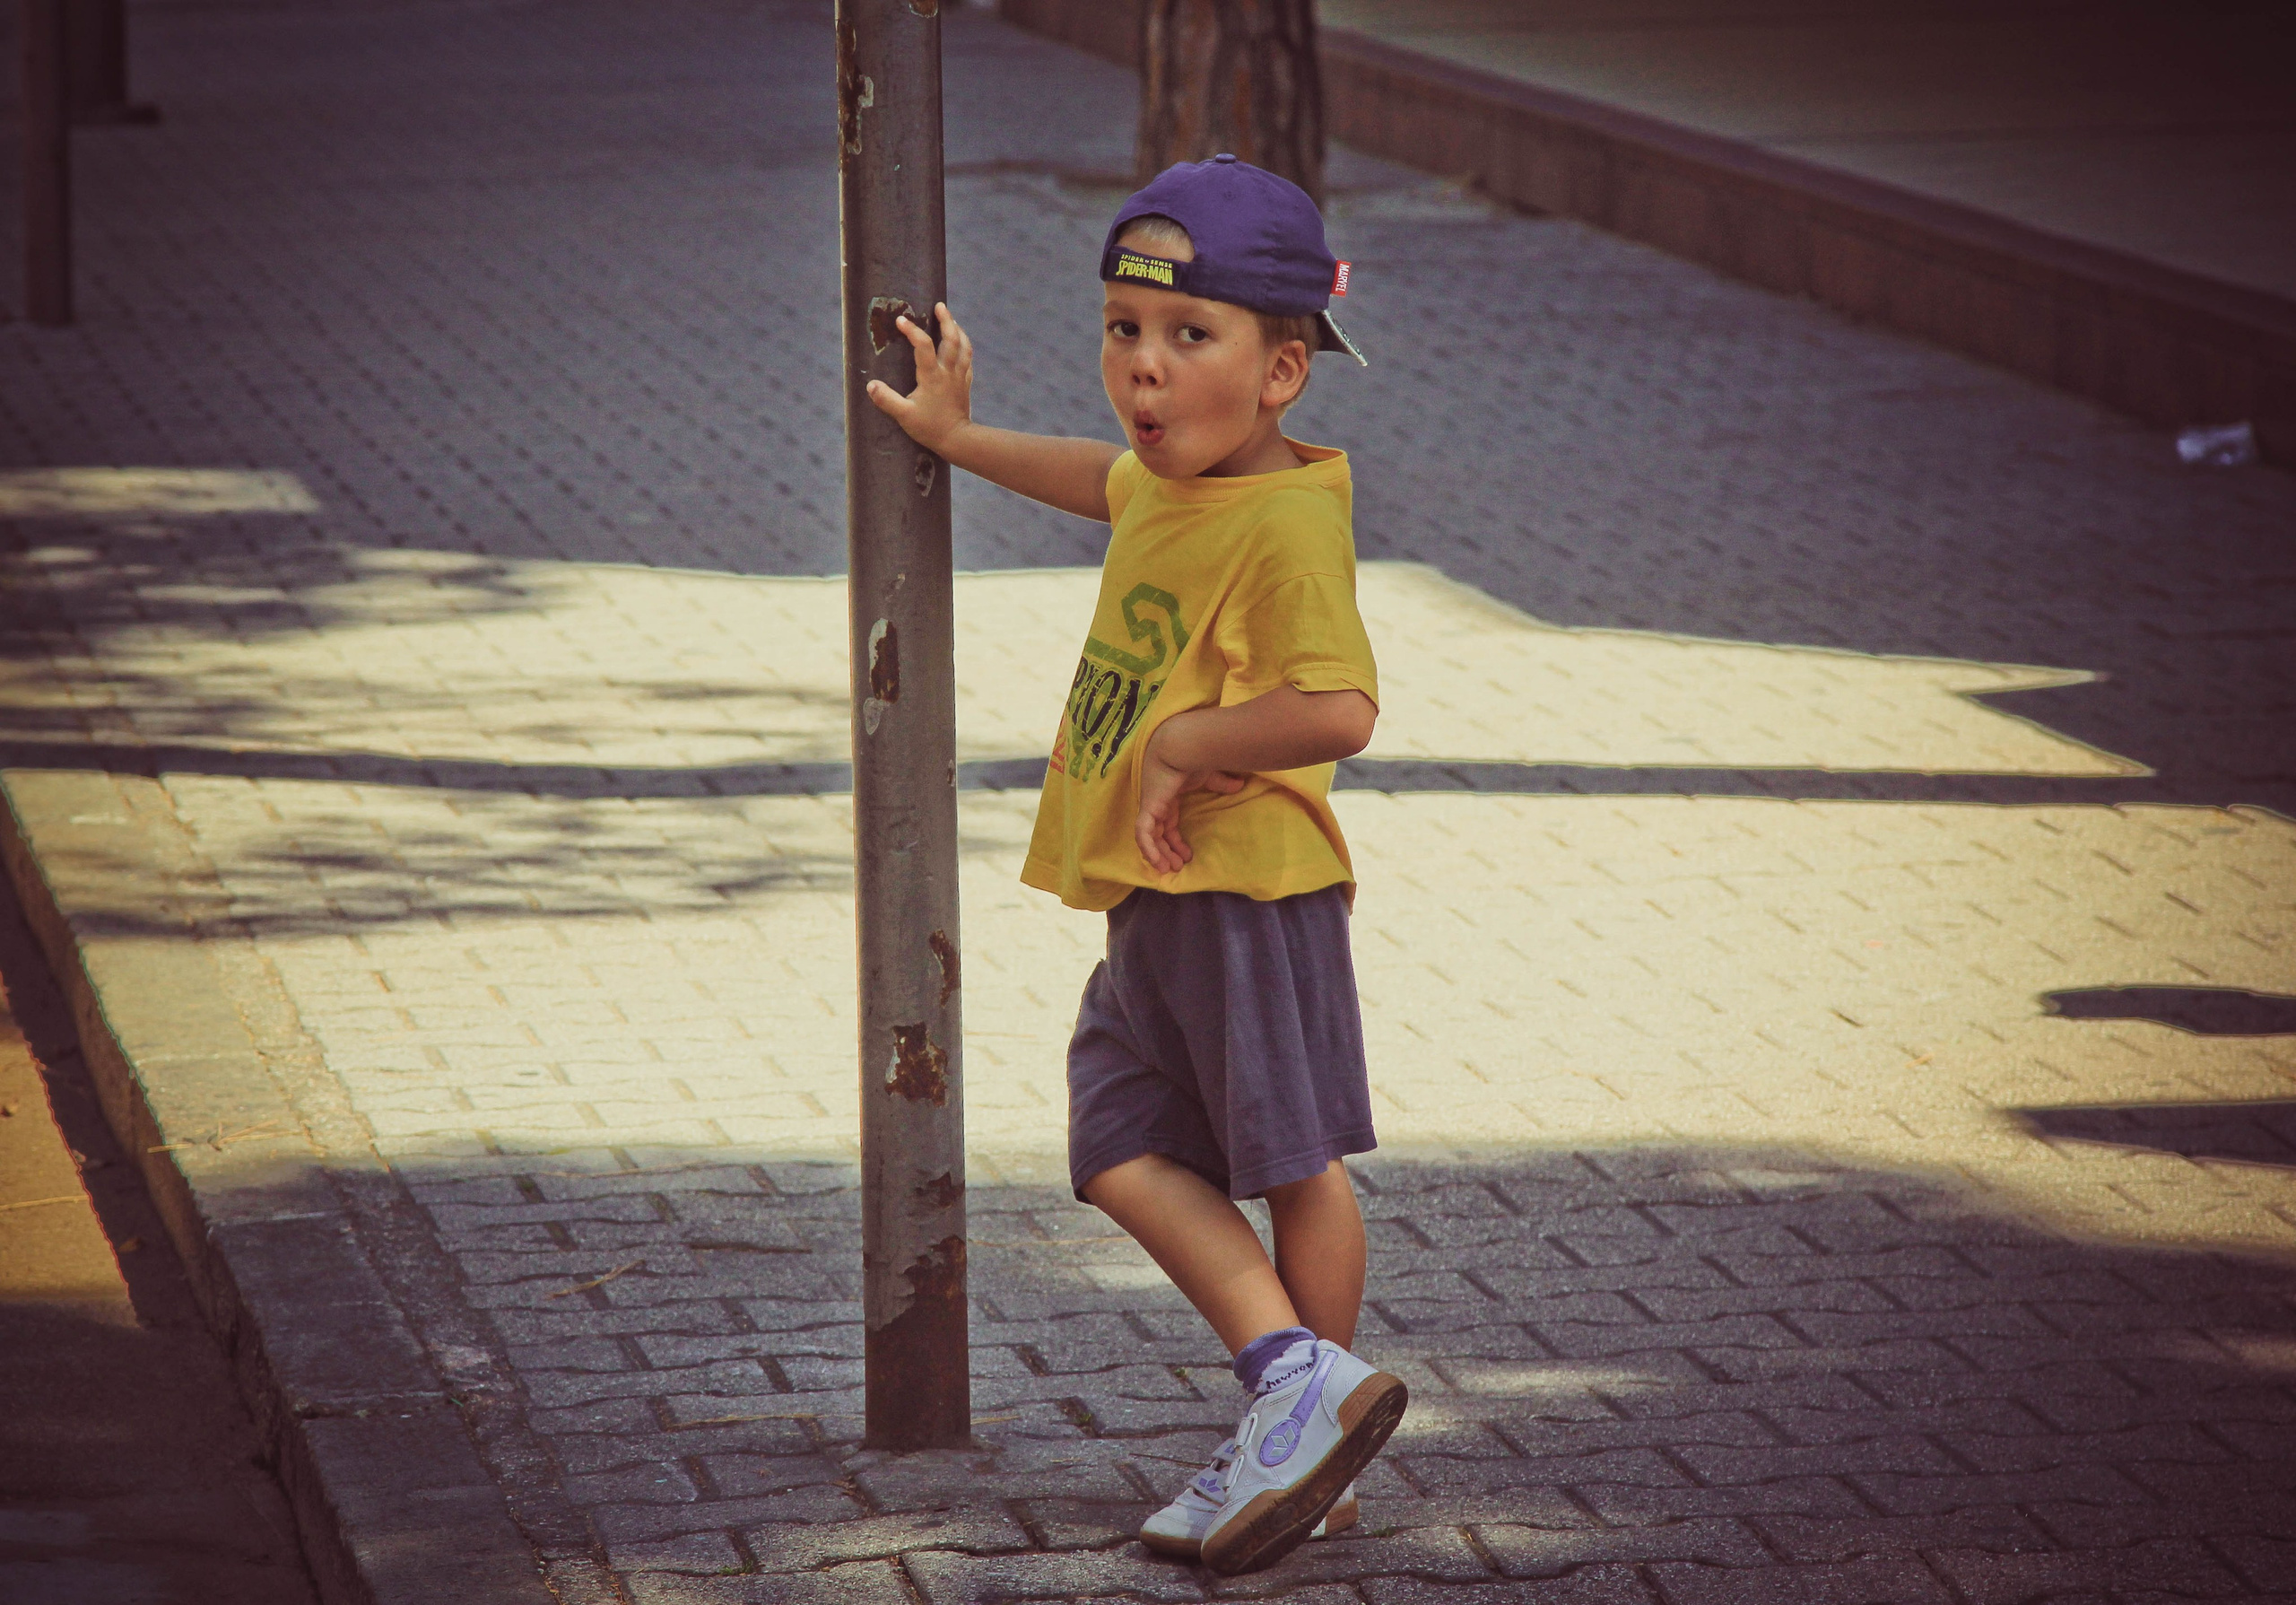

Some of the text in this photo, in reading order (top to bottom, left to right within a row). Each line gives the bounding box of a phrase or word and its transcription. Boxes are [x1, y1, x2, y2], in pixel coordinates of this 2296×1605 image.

[1116, 260, 1174, 285] SPIDER-MAN
[1121, 254, 1173, 268] SPIDER SENSE
[1335, 263, 1350, 292] MARVEL
